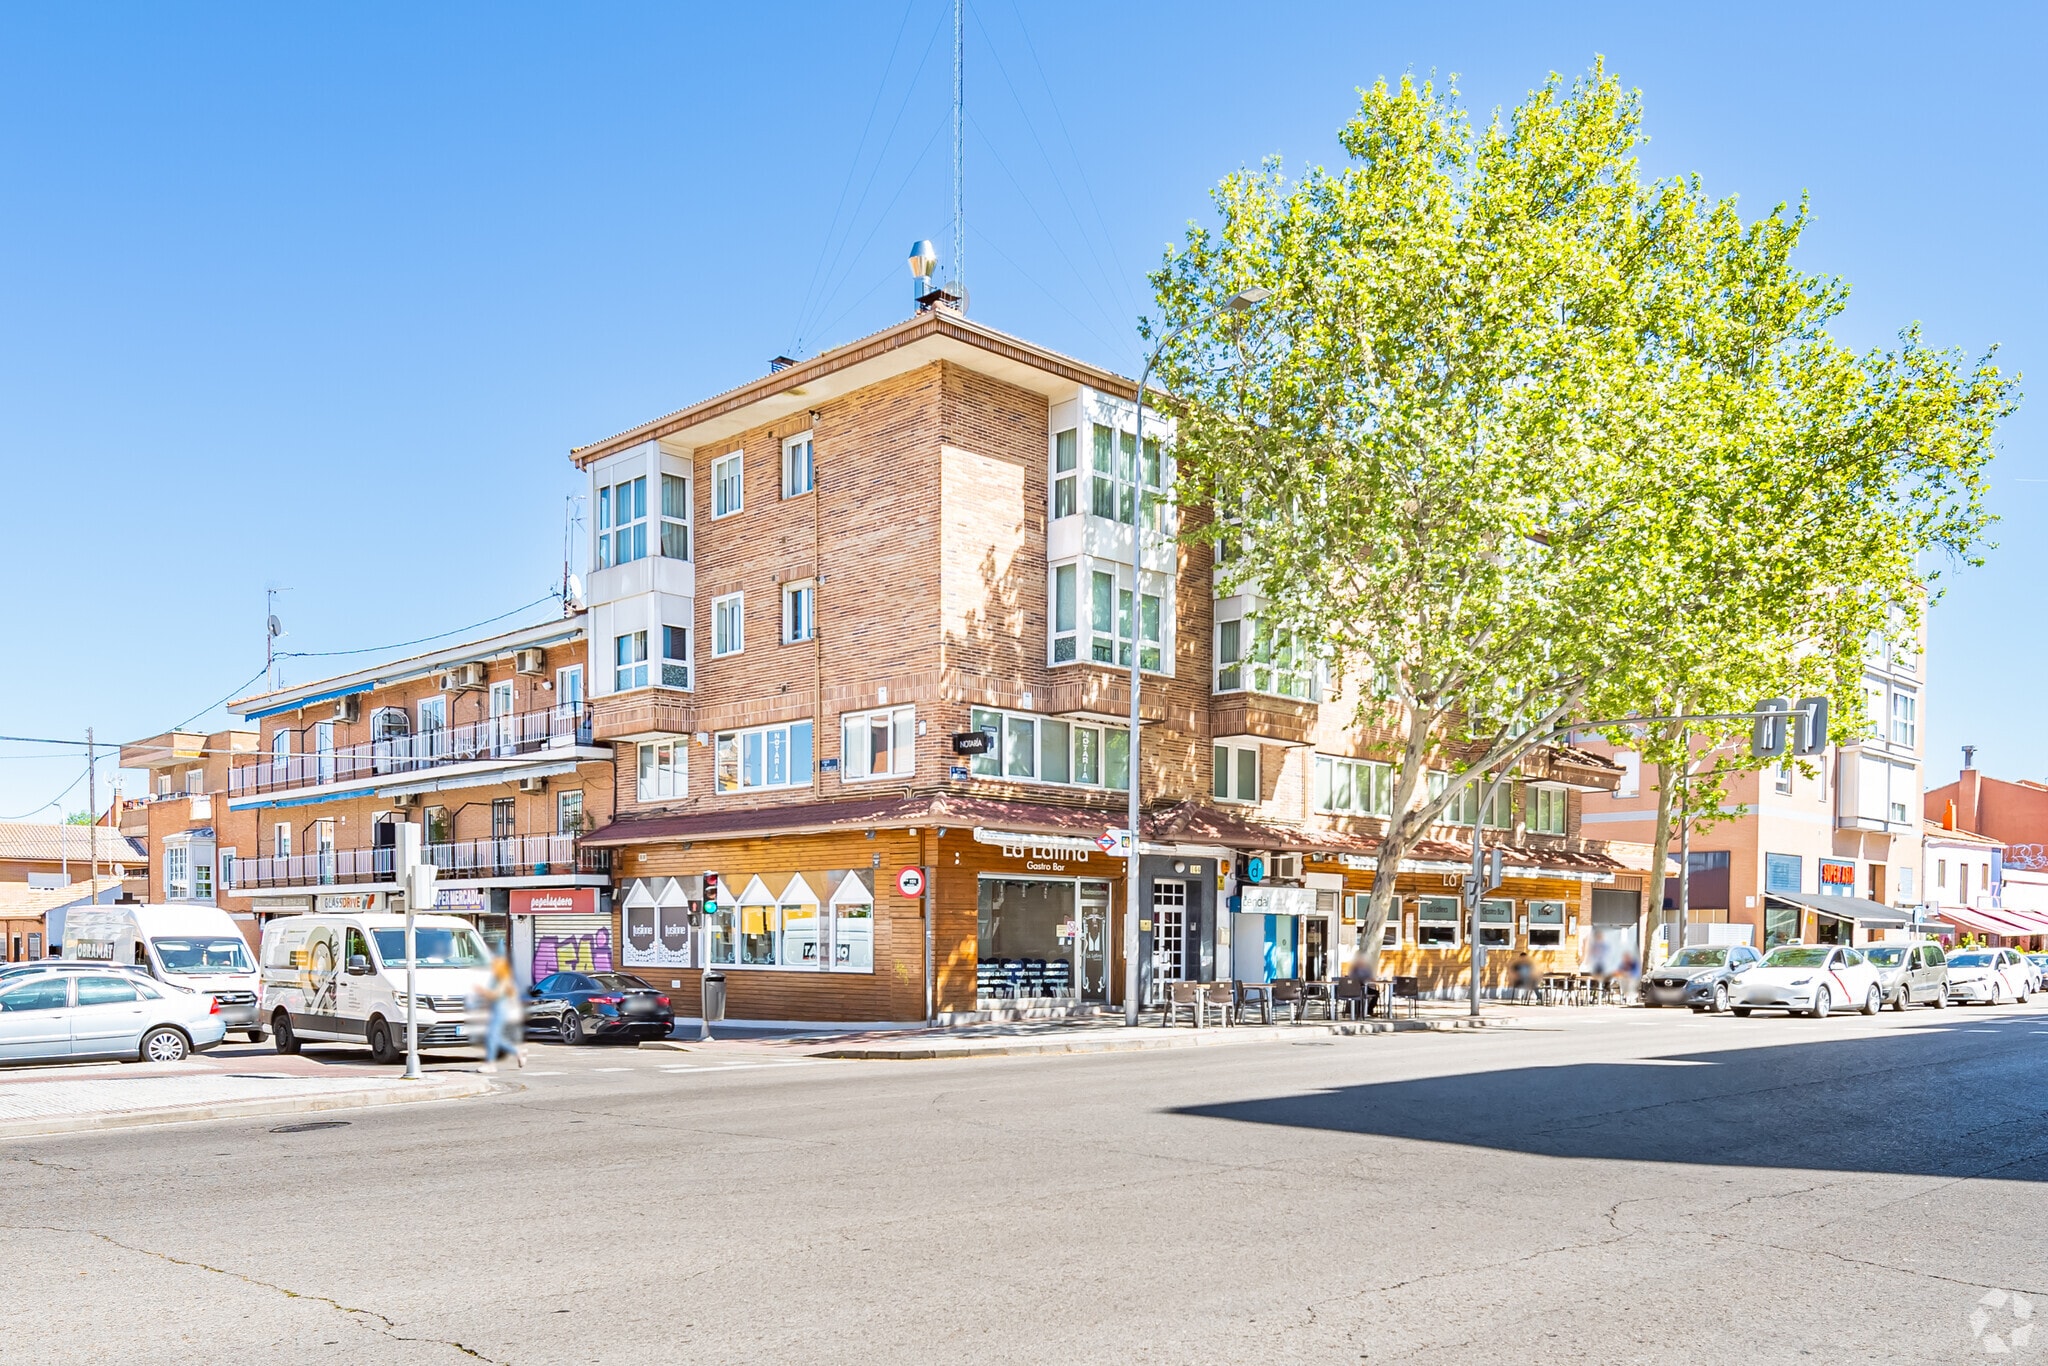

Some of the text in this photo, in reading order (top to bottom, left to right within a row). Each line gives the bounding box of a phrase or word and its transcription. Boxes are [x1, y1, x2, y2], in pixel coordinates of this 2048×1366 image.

[1026, 861, 1065, 871] Gastro Bar
[324, 896, 361, 908] GLASSDRIVE
[77, 943, 113, 959] OBRAMAT
